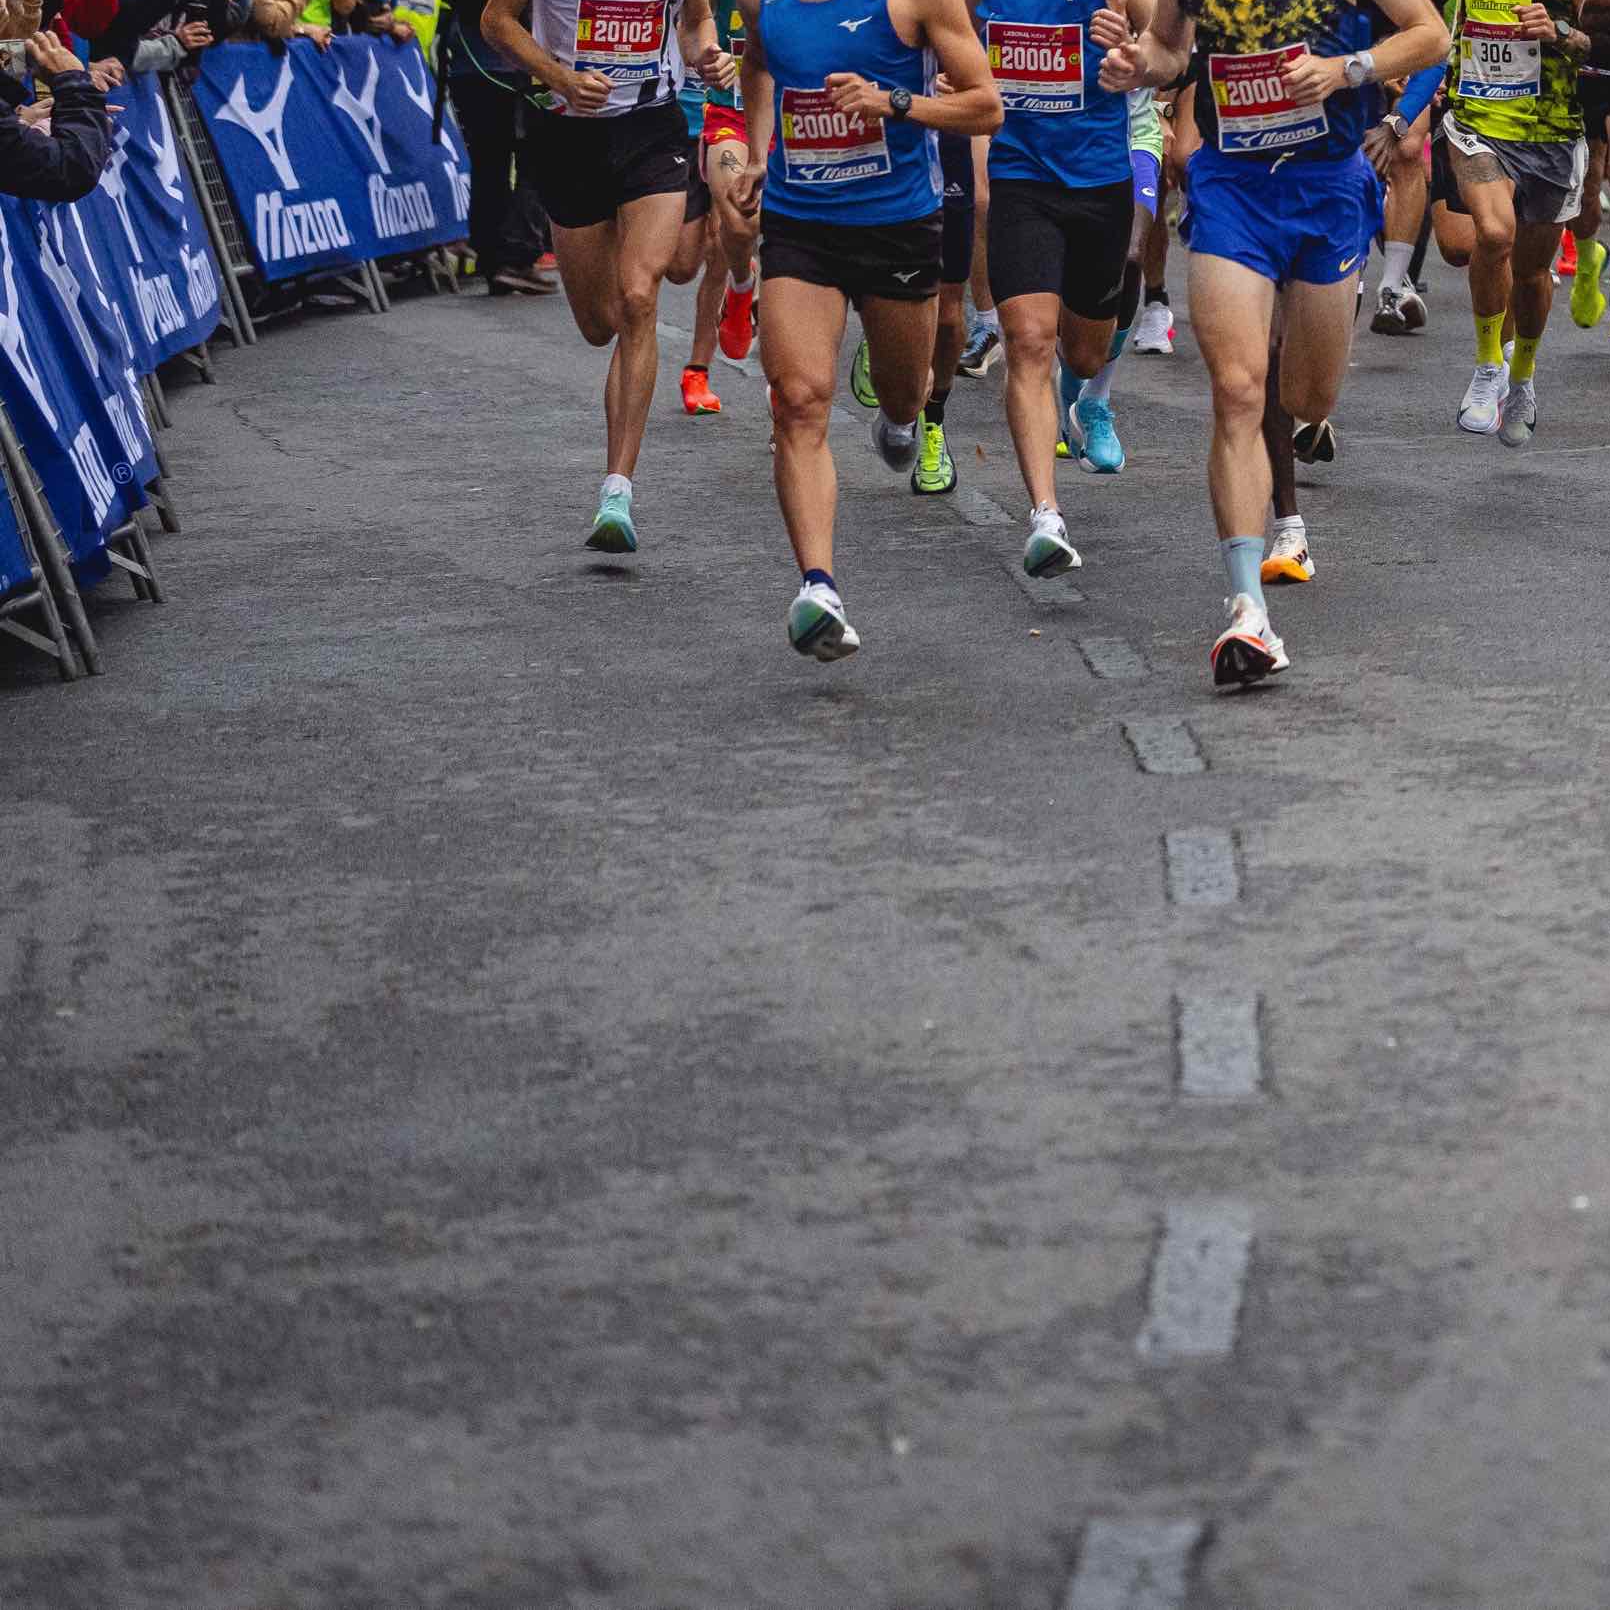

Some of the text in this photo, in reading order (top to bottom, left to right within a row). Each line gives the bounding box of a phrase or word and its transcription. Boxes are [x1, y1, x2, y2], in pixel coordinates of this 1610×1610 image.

[593, 20, 653, 43] 20102
[1001, 45, 1066, 72] 20006
[1480, 42, 1512, 64] 306
[1226, 76, 1291, 107] 2000
[793, 111, 865, 140] 20004
